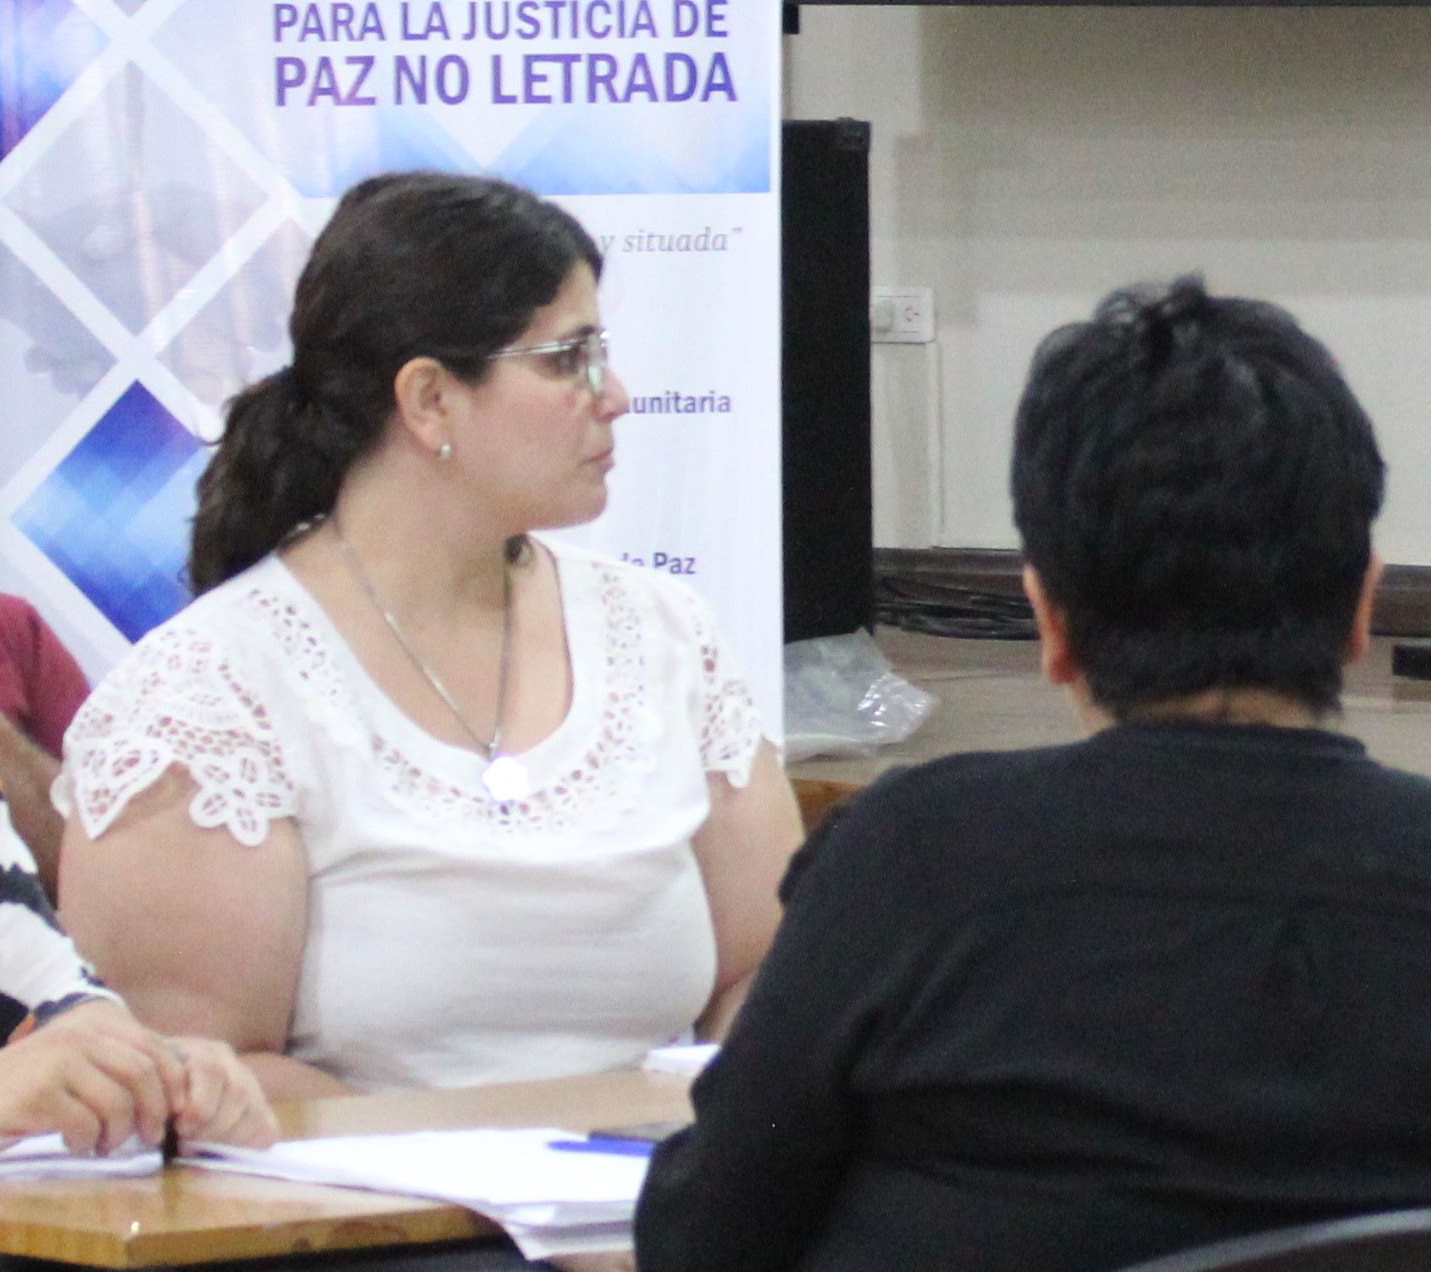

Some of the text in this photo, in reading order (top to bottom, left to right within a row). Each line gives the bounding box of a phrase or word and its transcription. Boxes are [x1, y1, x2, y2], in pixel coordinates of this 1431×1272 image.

[273, 1, 386, 43] PARA
[400, 0, 451, 42] LA
[462, 0, 659, 41] JUSTICIA
[275, 51, 738, 107] PAZ NO LETRADA
[629, 390, 732, 414] unitaria
[653, 551, 696, 575] Paz
